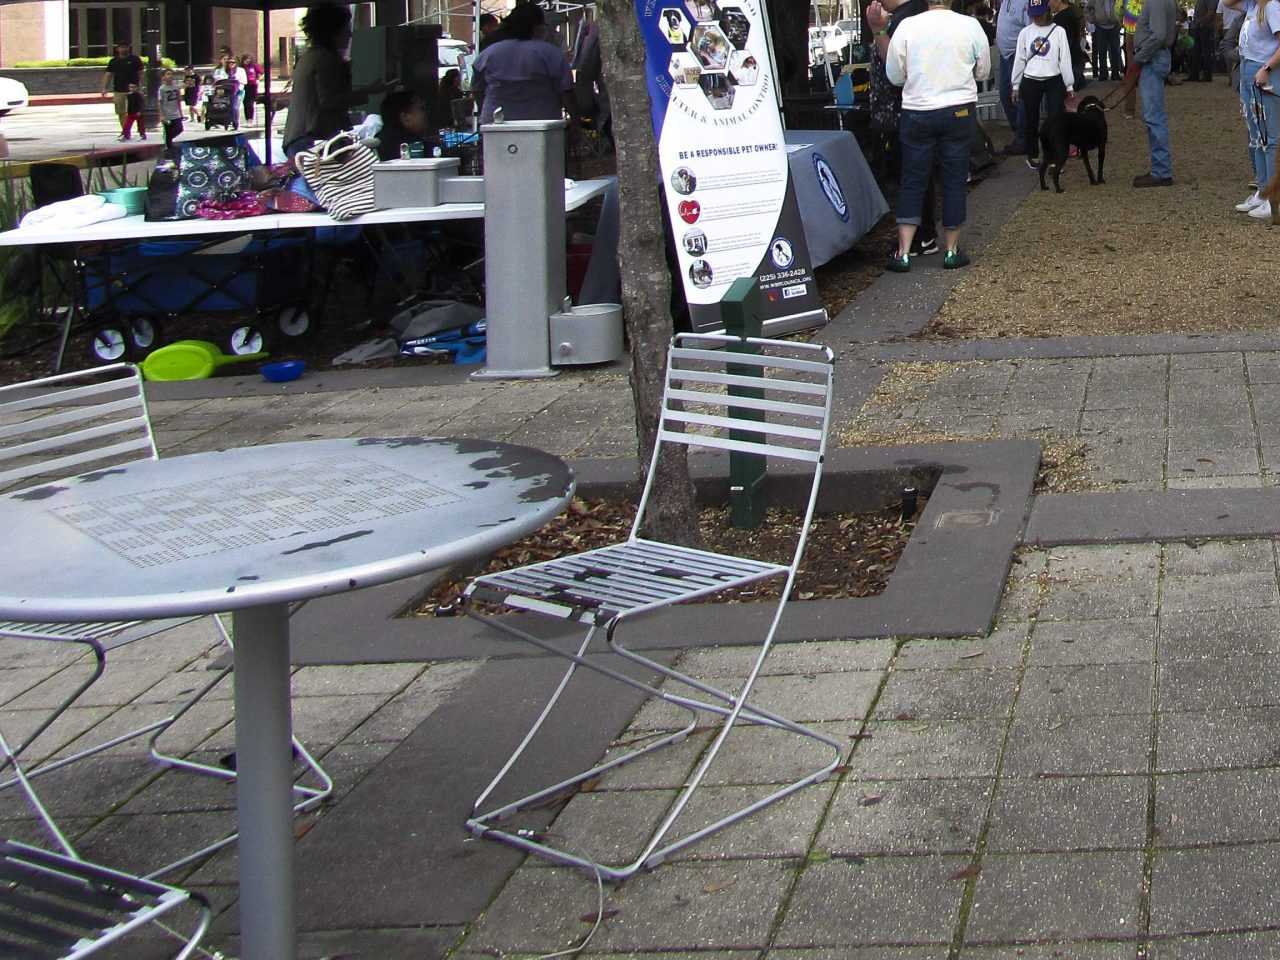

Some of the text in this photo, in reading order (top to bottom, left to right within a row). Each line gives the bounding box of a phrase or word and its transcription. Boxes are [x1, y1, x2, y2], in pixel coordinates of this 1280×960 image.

[679, 151, 689, 160] BE
[696, 146, 741, 158] RESPONSIBLE
[742, 146, 753, 154] PET
